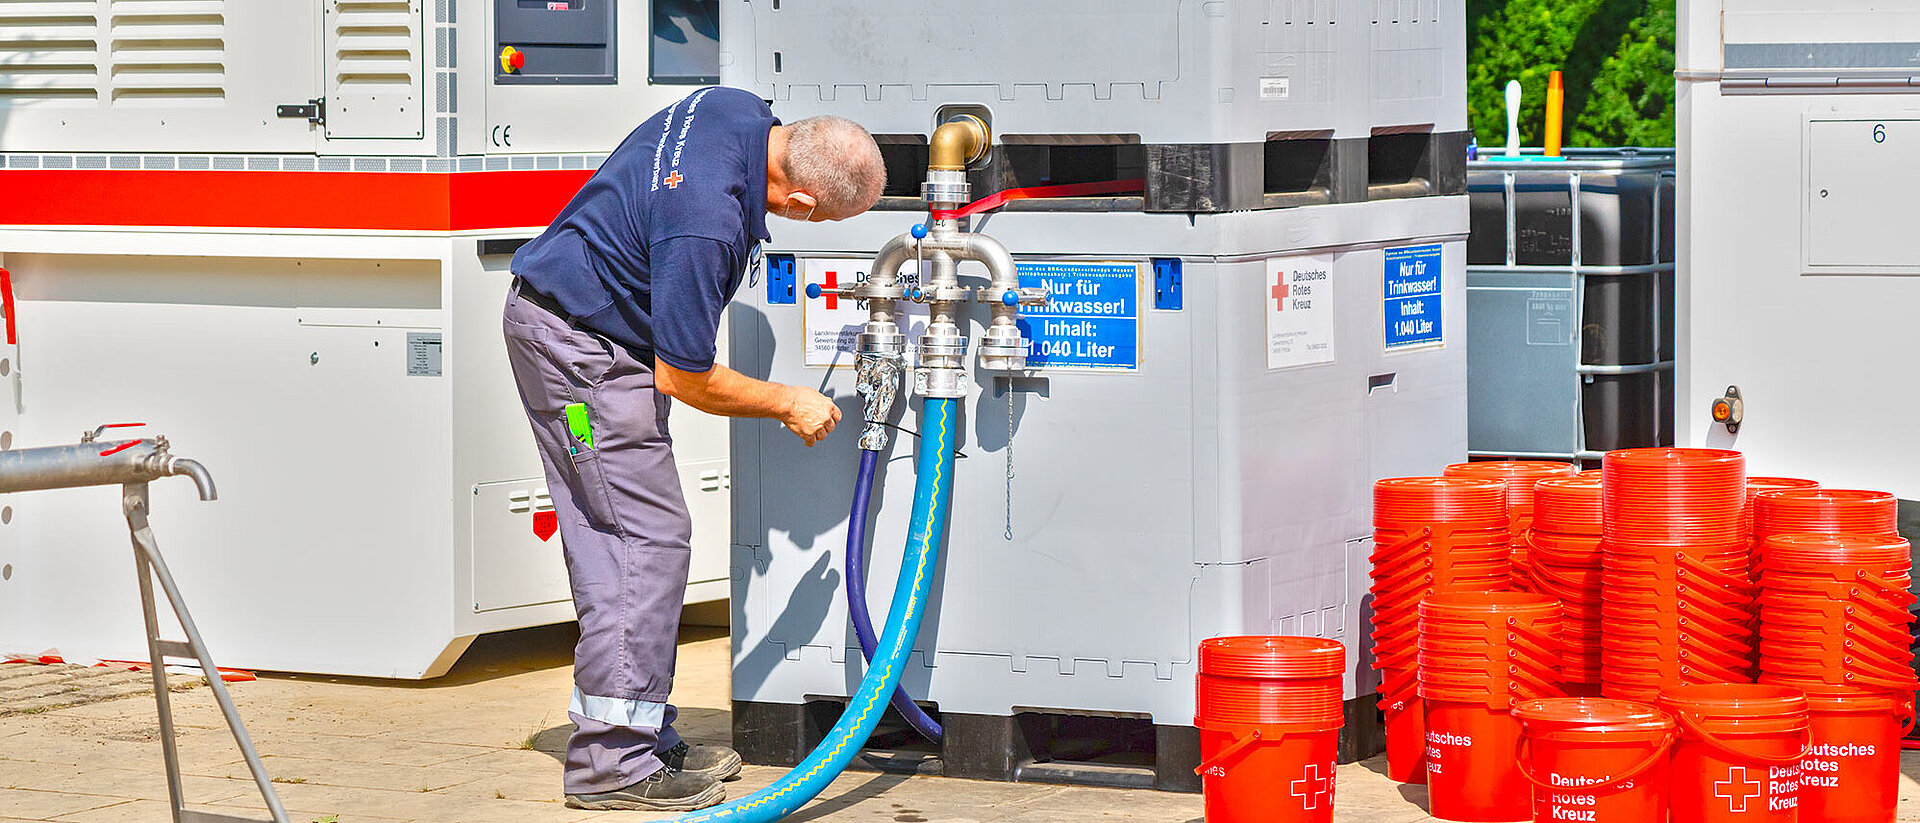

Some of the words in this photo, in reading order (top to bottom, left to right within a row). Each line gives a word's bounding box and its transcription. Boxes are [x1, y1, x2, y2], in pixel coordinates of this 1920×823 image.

[492, 125, 511, 147] CE
[679, 114, 695, 140] Rotes
[1873, 123, 1886, 144] 6
[672, 140, 686, 168] Kreuz
[1292, 270, 1327, 282] Deutsches
[1399, 261, 1415, 277] Nur
[1415, 260, 1426, 276] für
[1041, 278, 1072, 295] Nur
[1075, 279, 1101, 296] für
[1292, 284, 1312, 296] Rotes
[1388, 276, 1437, 295] Trinkwasser!
[1292, 298, 1312, 310] Kreuz
[1400, 300, 1425, 316] Inhalt:
[1044, 319, 1097, 337] Inhalt:
[1394, 320, 1415, 337] 1.040
[1415, 318, 1433, 335] Liter
[1028, 340, 1072, 357] 1.040
[1076, 341, 1115, 358] Liter
[1769, 779, 1799, 795] Rotes
[1552, 792, 1596, 806] Rotes
[1768, 795, 1798, 811] Kreuz
[1552, 804, 1596, 822] Kreuz
